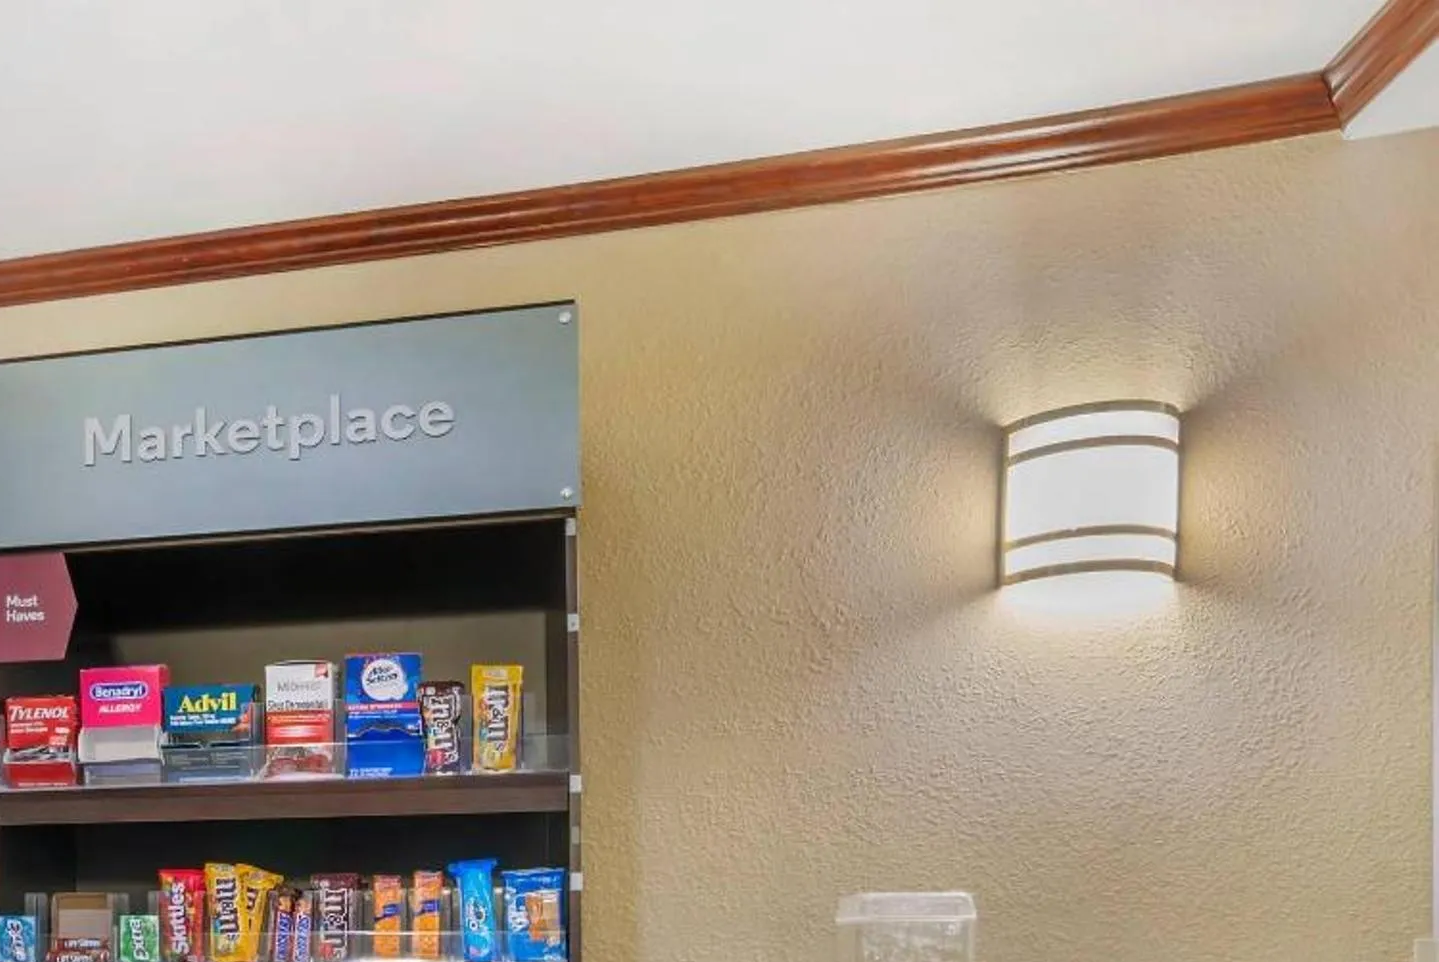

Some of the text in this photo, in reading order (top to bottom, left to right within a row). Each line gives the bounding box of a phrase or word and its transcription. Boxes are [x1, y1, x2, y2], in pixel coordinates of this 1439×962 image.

[83, 394, 456, 467] Marketplace
[6, 594, 38, 609] Must
[6, 609, 45, 623] Haves
[94, 682, 143, 699] Benadryl
[98, 703, 142, 714] ALLERGY
[177, 691, 237, 713] Advil
[9, 705, 70, 721] TYLENOL
[171, 881, 189, 955] Skittles
